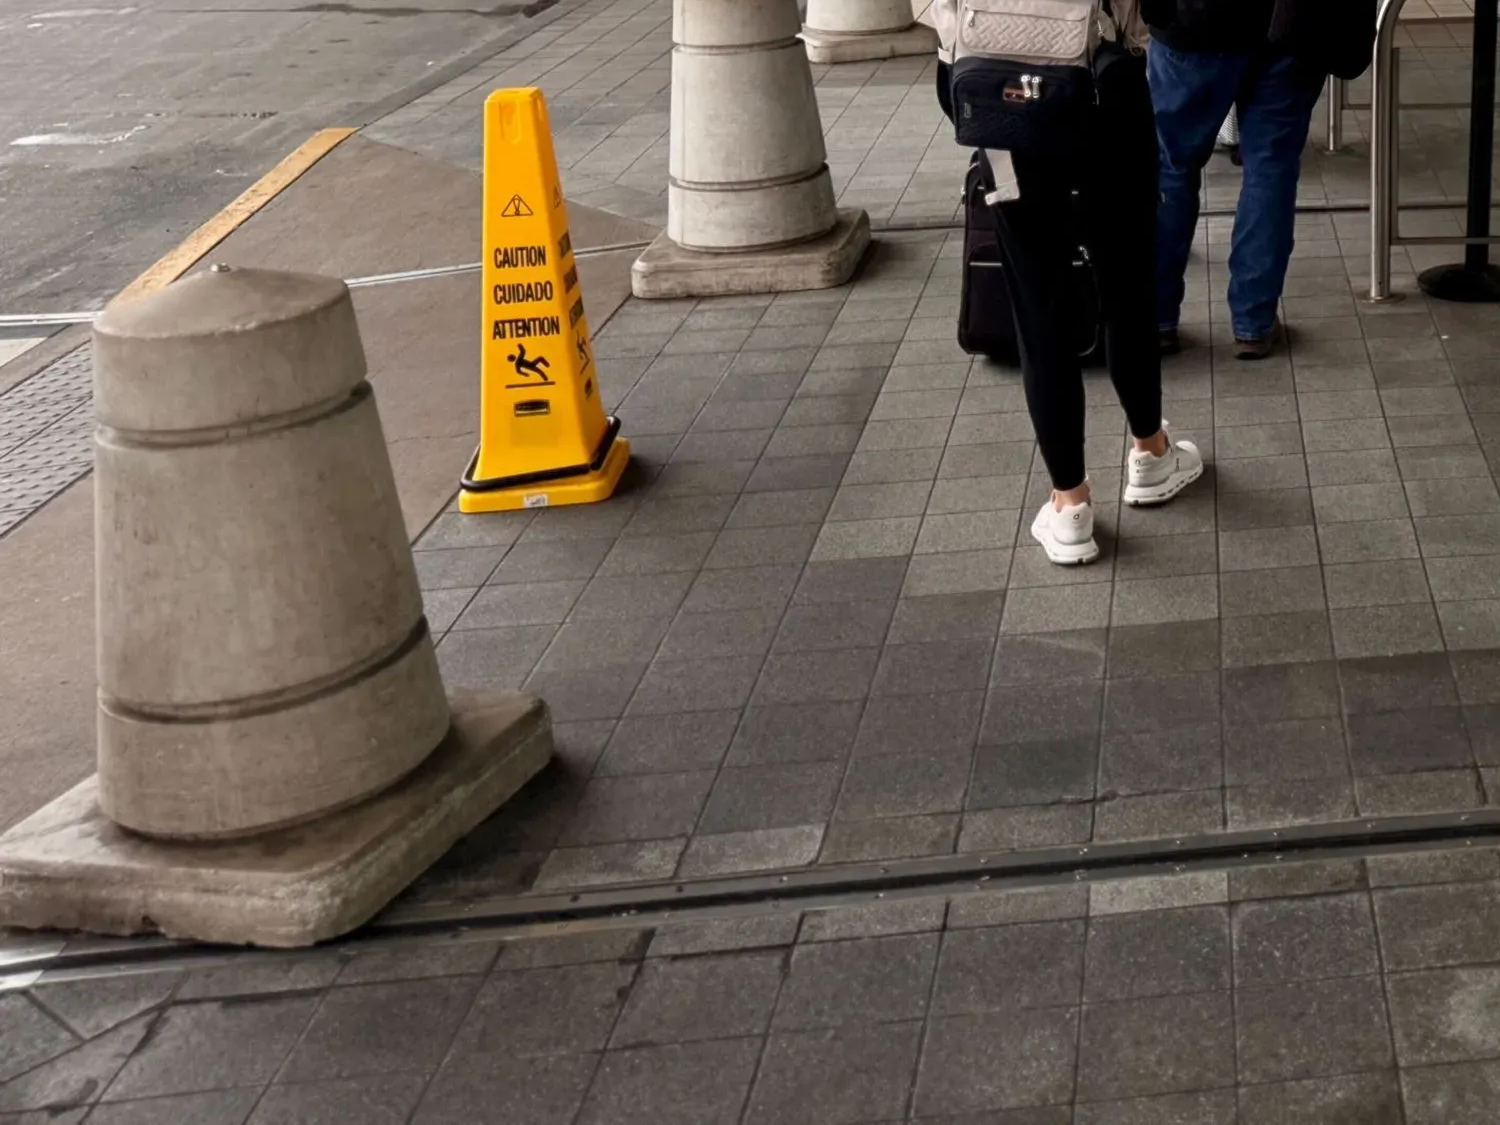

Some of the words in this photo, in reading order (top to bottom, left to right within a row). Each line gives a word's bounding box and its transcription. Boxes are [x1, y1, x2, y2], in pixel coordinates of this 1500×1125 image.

[494, 246, 546, 269] CAUTION
[494, 280, 553, 305] CUIDADO
[492, 315, 560, 340] ATTENTION
